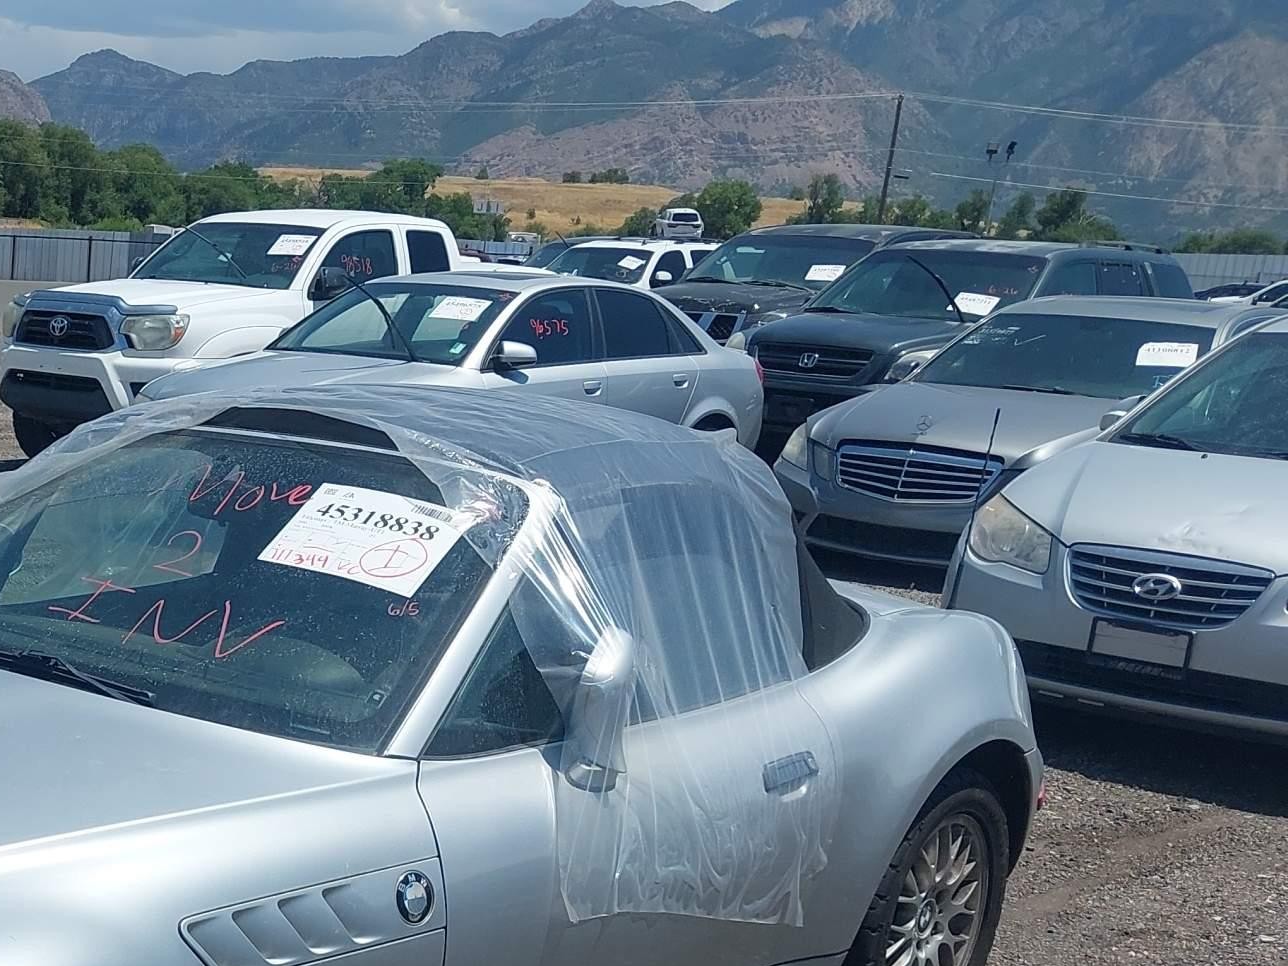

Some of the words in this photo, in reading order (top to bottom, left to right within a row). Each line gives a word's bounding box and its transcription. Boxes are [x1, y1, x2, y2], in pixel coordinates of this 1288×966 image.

[315, 503, 441, 541] 45318838
[152, 530, 204, 577] 2
[387, 599, 420, 616] 6/5
